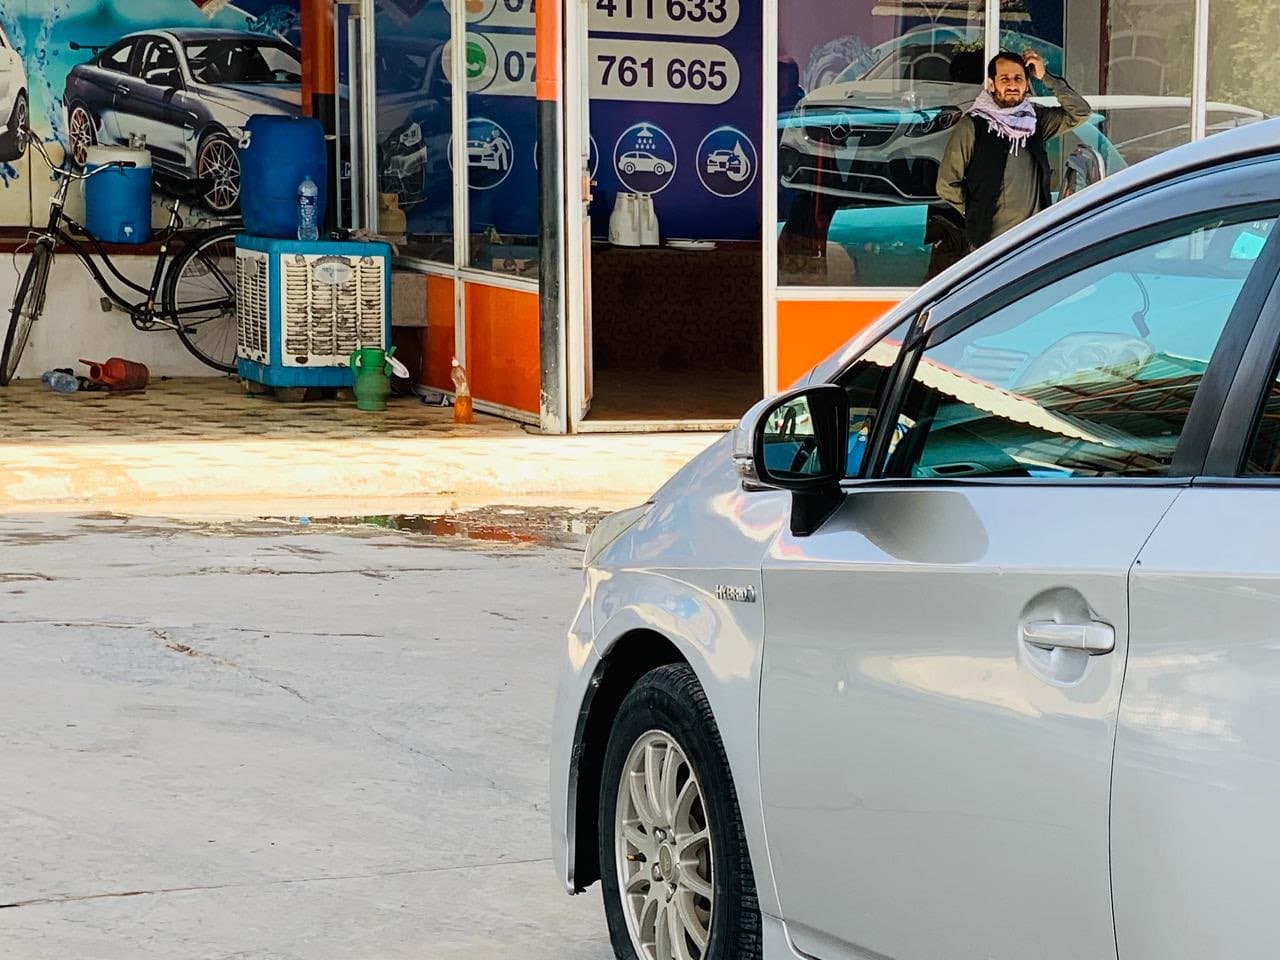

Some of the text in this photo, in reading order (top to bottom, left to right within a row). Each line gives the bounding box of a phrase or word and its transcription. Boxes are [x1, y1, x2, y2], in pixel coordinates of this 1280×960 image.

[665, 0, 728, 23] 633
[597, 55, 654, 88] 761
[666, 59, 728, 91] 665
